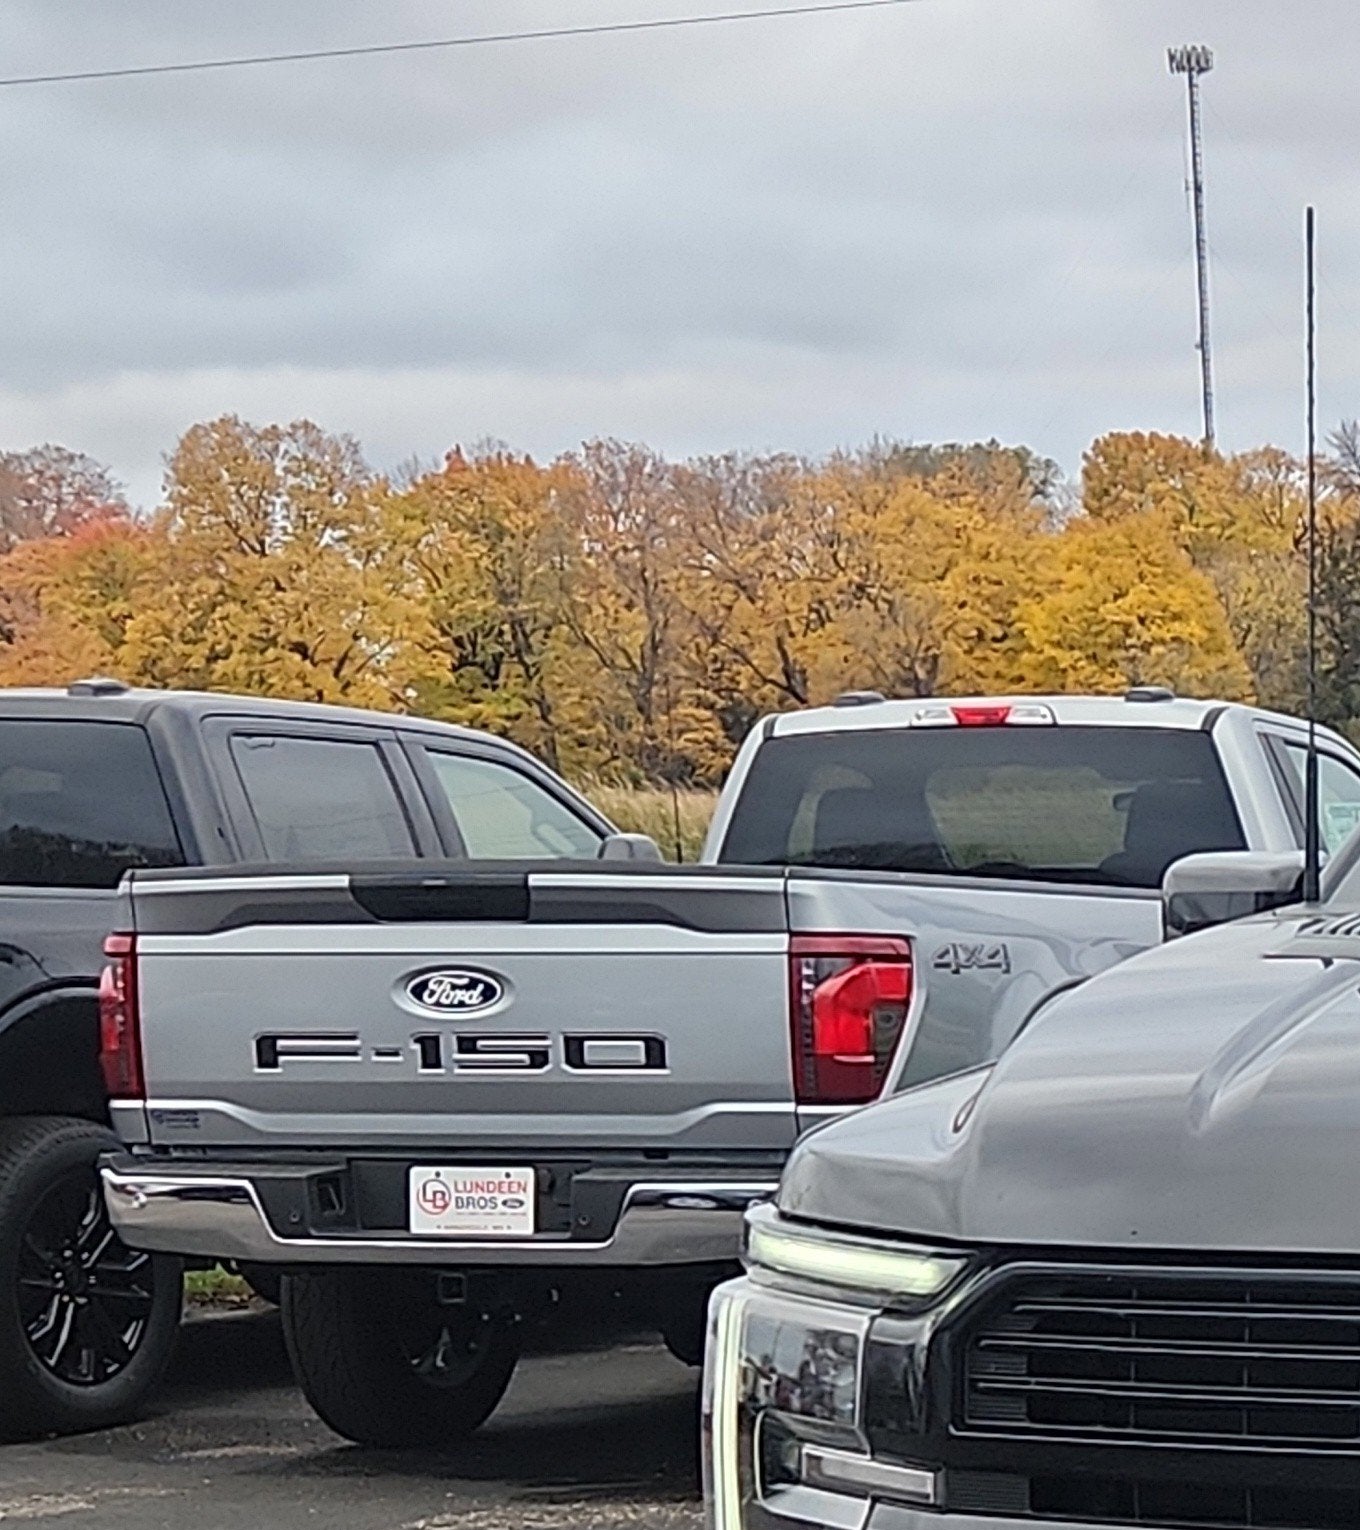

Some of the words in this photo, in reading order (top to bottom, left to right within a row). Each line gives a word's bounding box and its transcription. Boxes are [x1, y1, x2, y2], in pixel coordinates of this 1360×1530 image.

[422, 974, 484, 1005] Ford
[252, 1029, 672, 1076] F-150
[454, 1180, 528, 1194] LUNDEEN
[454, 1195, 499, 1210] BROS
